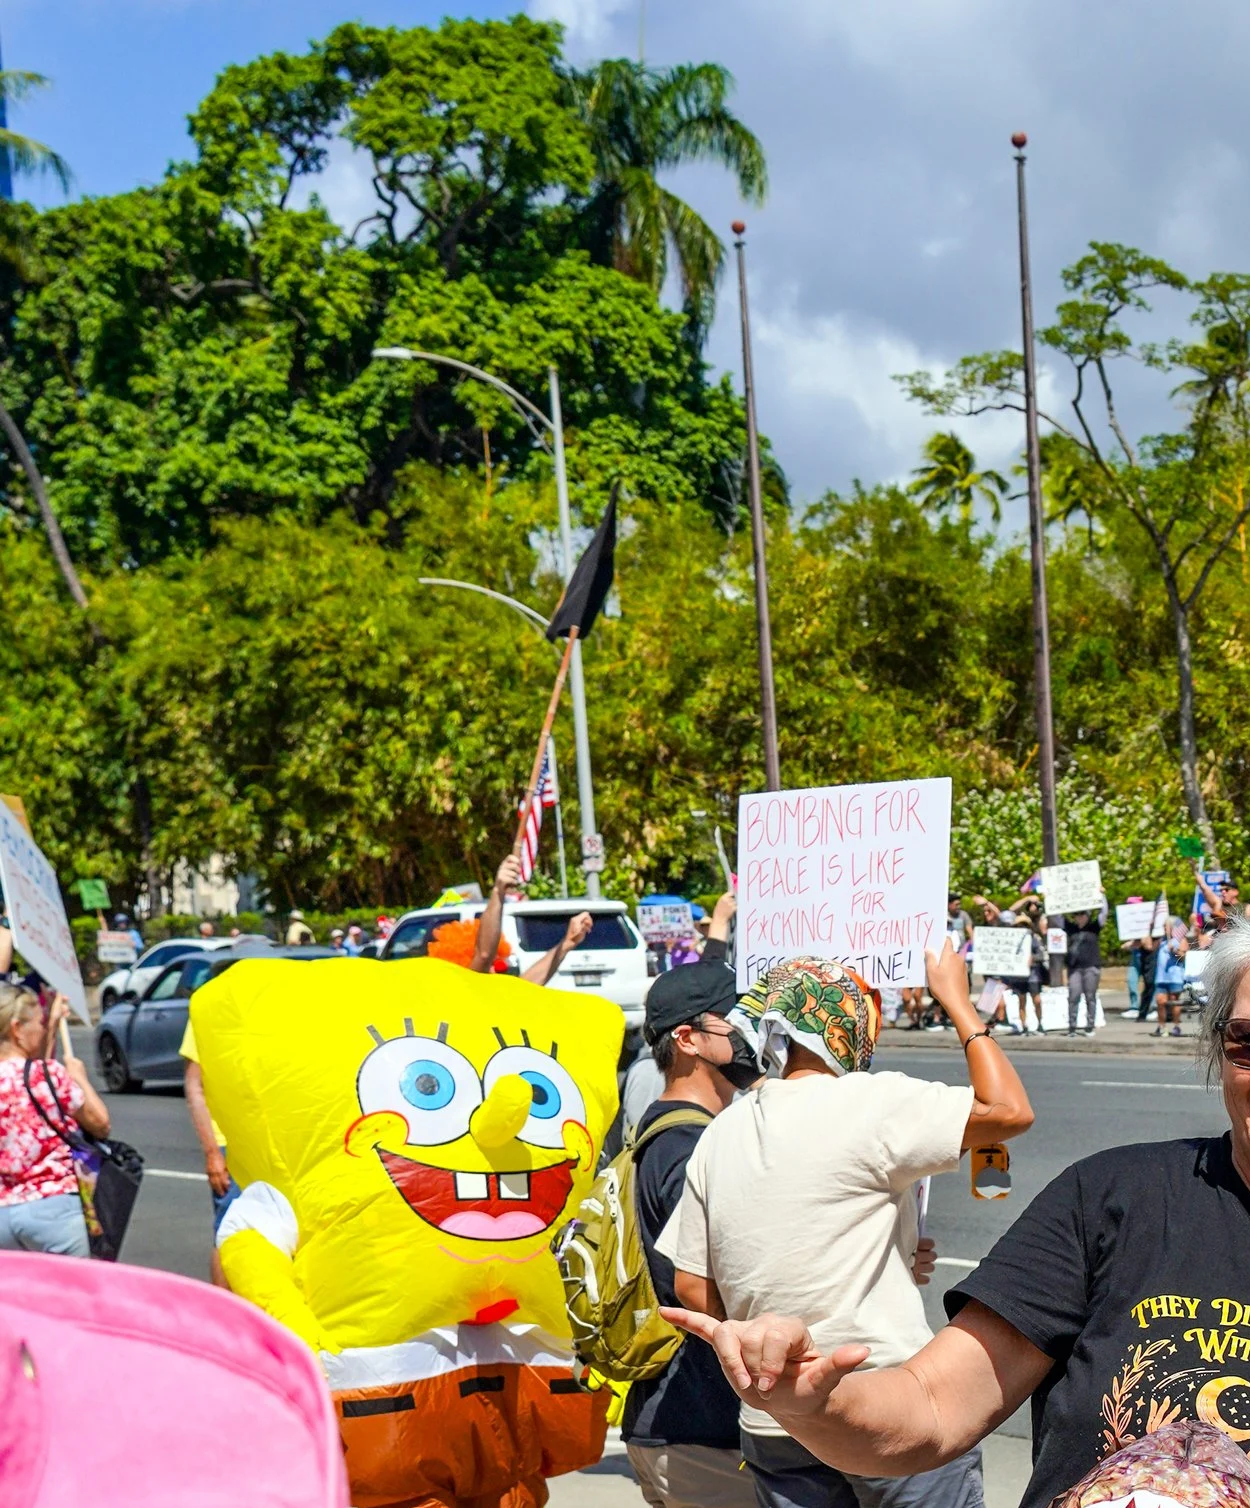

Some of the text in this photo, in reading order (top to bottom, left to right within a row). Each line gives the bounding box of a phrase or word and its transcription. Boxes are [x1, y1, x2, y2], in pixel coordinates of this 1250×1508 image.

[746, 787, 926, 852] BOMBING FOR
[746, 847, 905, 902] PEACE IS LIKE
[851, 889, 886, 917] FOR
[844, 911, 934, 951] VIRGINITY
[745, 953, 786, 986] FR
[1130, 1294, 1202, 1329] THEY
